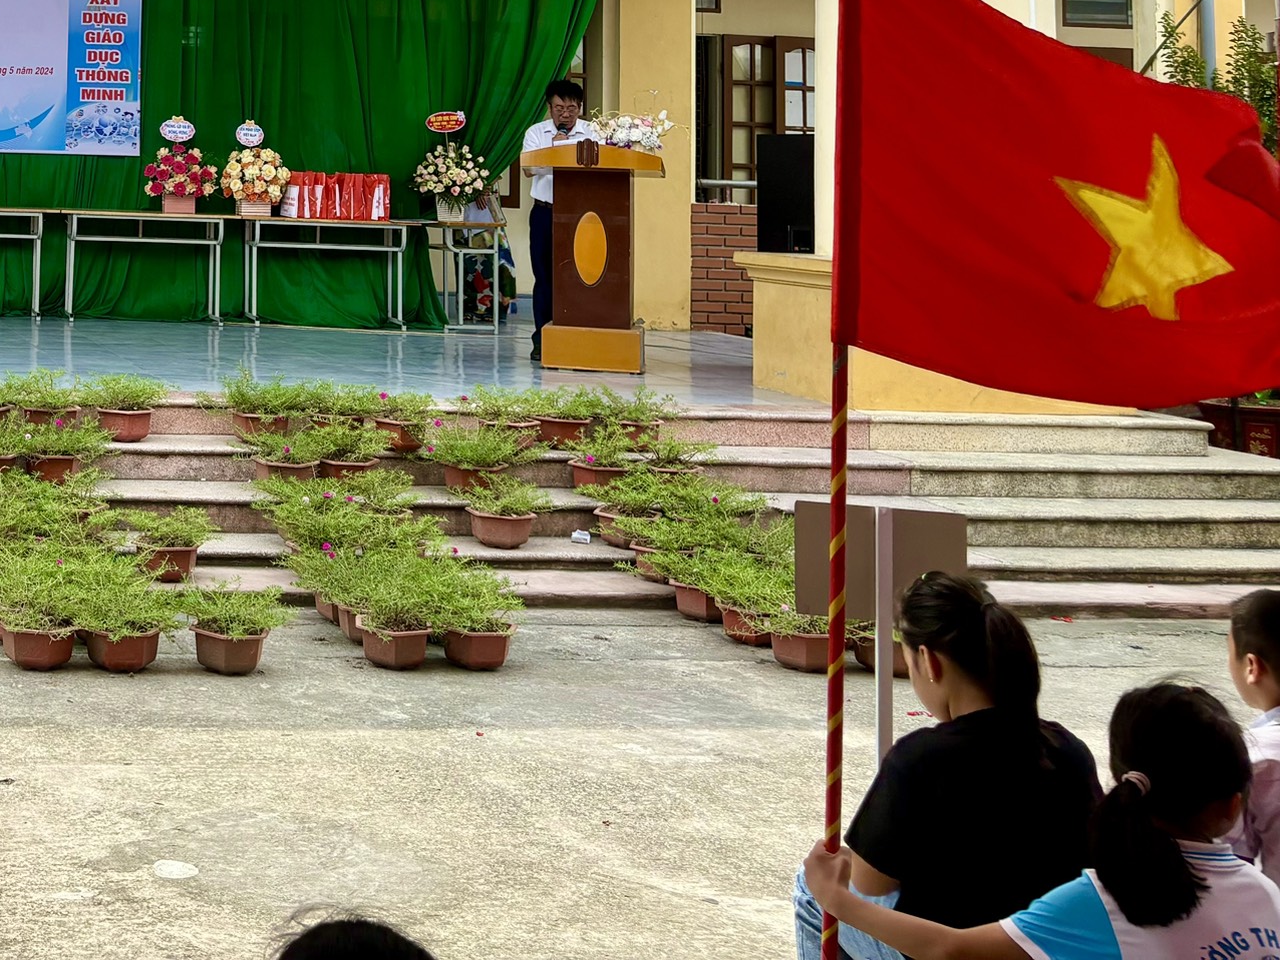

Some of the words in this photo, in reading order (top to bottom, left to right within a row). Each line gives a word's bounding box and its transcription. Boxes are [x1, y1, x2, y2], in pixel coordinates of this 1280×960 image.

[82, 11, 127, 27] DỰNG
[85, 29, 123, 44] GIÁO
[87, 50, 120, 65] DỤC
[9, 66, 15, 74] 5
[16, 66, 33, 75] năm
[35, 67, 54, 75] 2024
[76, 67, 130, 82] THÔNG
[81, 88, 125, 101] MINH
